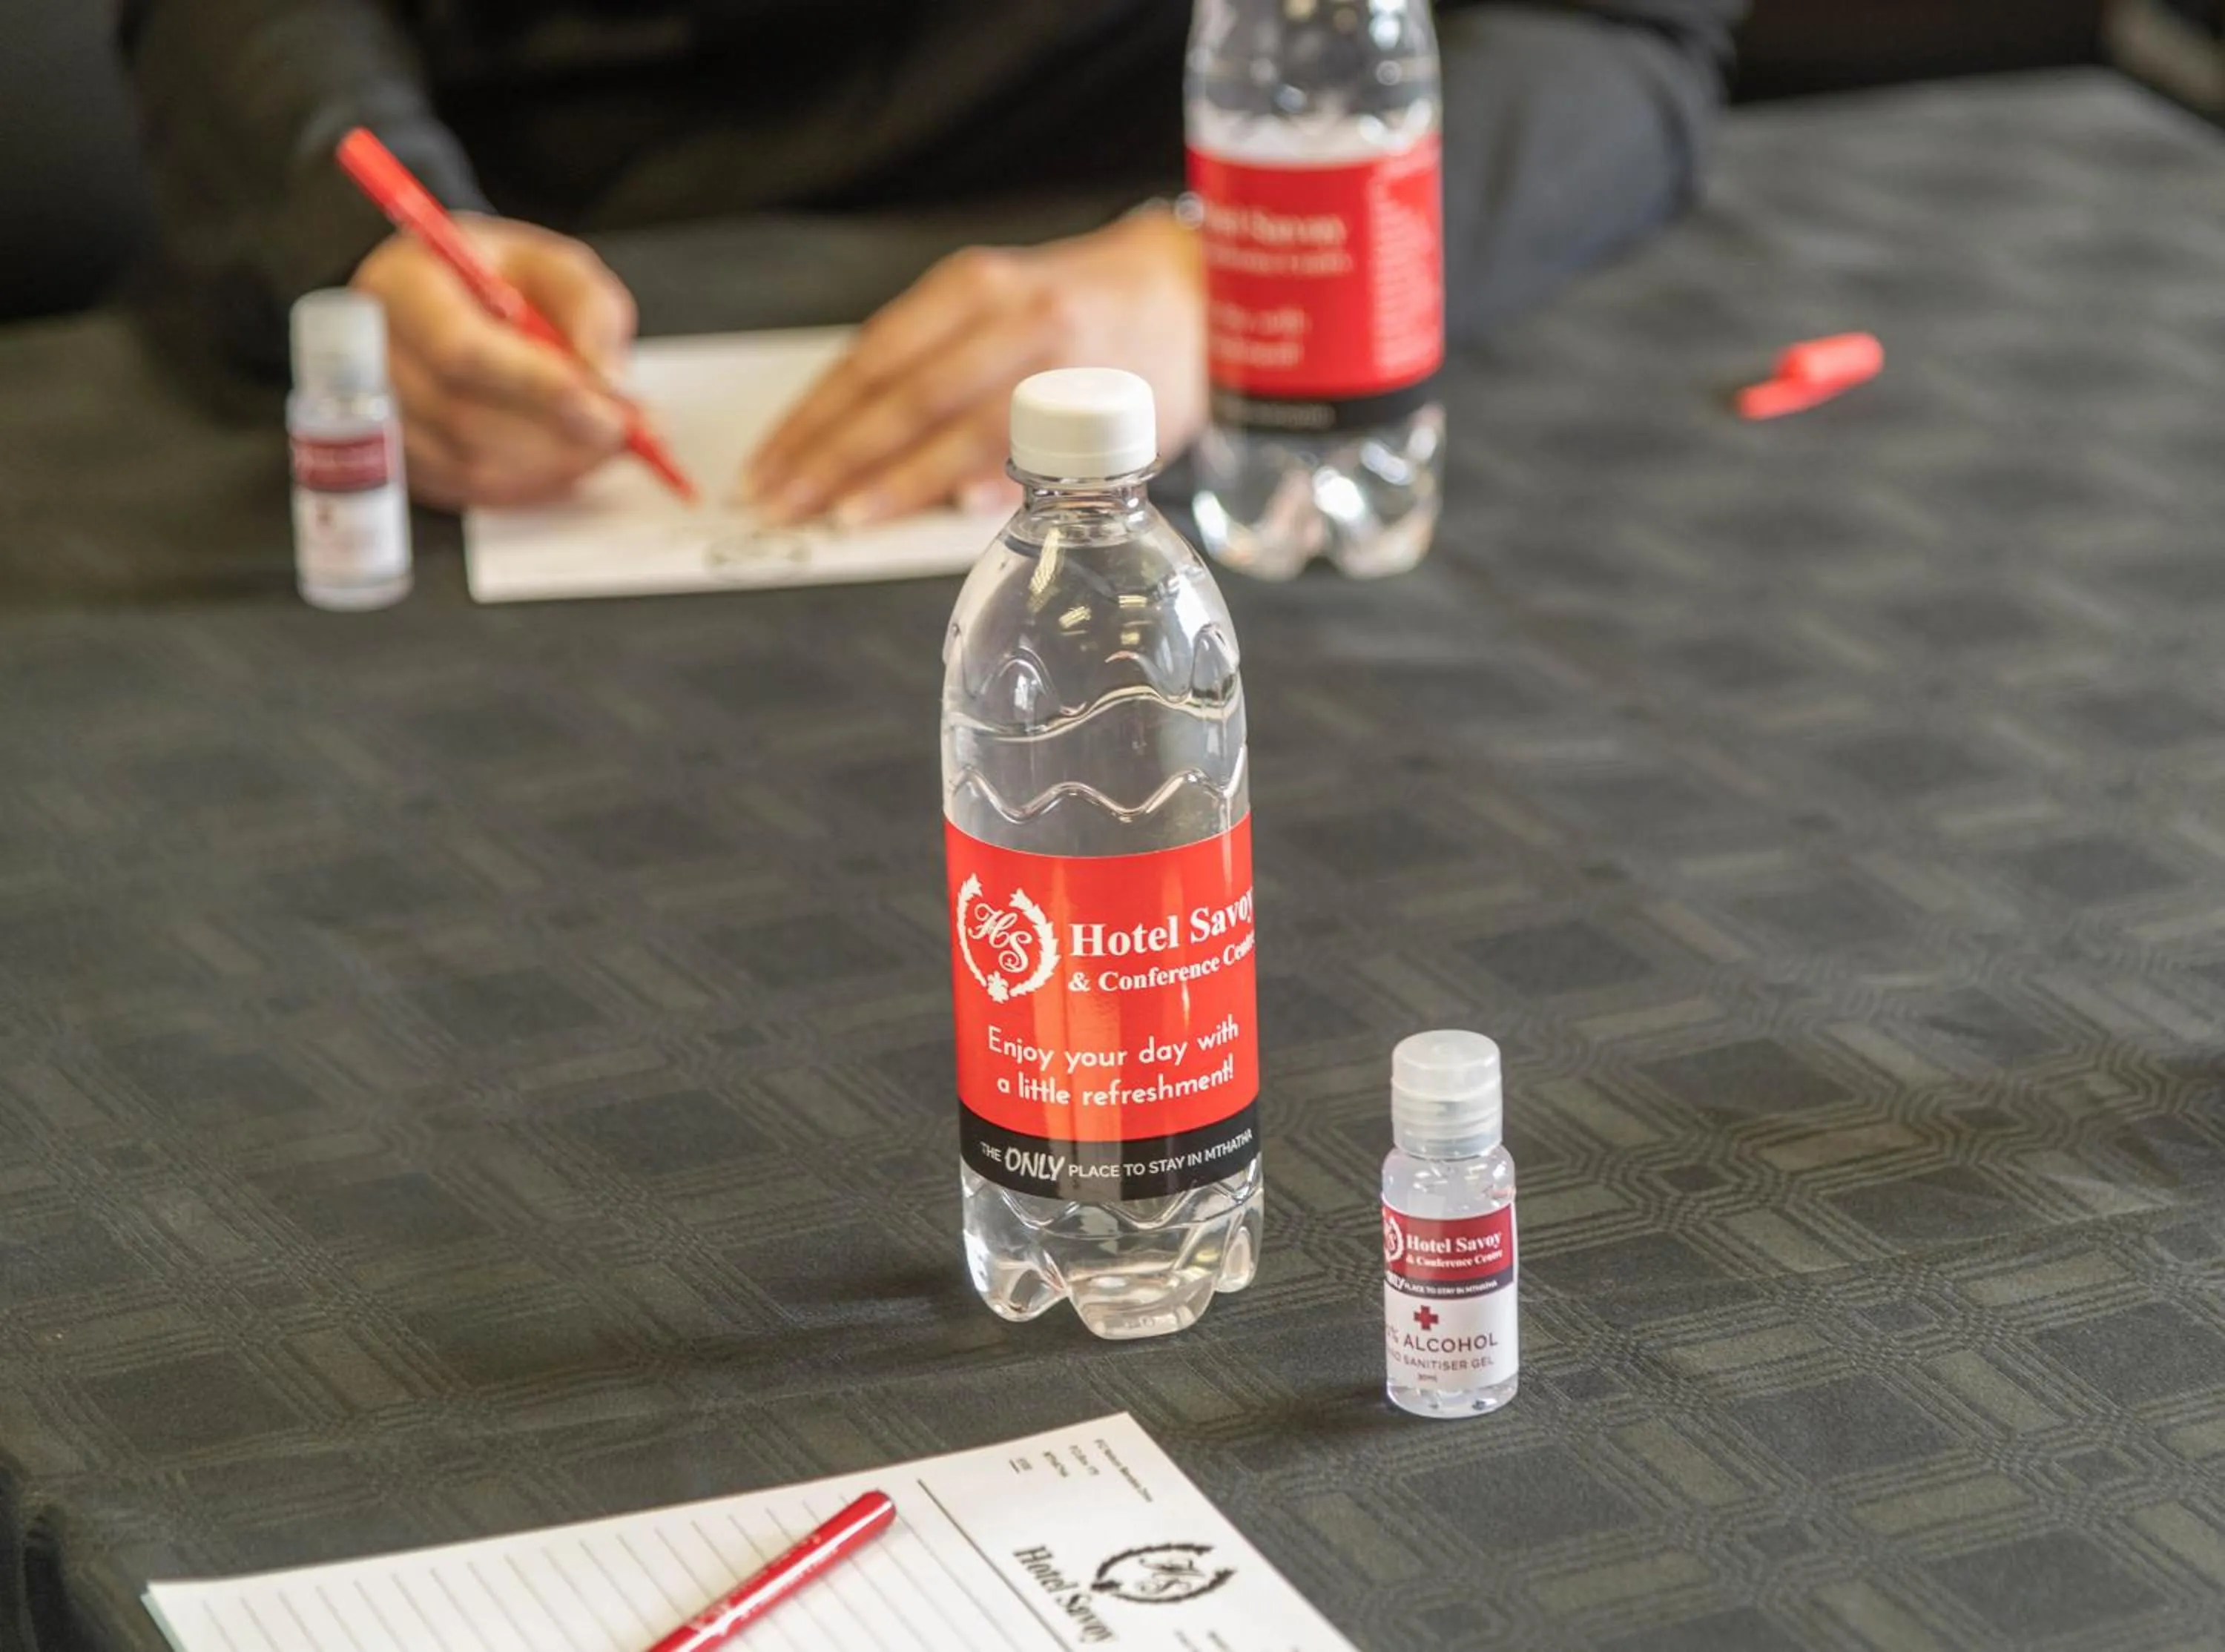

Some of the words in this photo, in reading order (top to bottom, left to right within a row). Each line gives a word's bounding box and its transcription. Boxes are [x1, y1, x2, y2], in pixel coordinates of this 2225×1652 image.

[1069, 915, 1179, 957] Hotel
[1068, 972, 1091, 992] &
[1098, 957, 1220, 992] Conference
[988, 1025, 1053, 1071] Enjoy
[1065, 1049, 1127, 1074] your
[1138, 1036, 1187, 1065] day
[1196, 1014, 1239, 1051] with
[997, 1077, 1009, 1094] a
[1018, 1072, 1070, 1105] little
[1081, 1054, 1235, 1106] refreshment!
[979, 1140, 1002, 1162] THE
[1004, 1146, 1066, 1181] ONLY
[1068, 1164, 1121, 1177] PLACE
[1123, 1163, 1145, 1177] TO
[1149, 1155, 1185, 1174] STAY
[1187, 1152, 1202, 1166] IN
[1204, 1128, 1253, 1162] MTHATHA
[1405, 1234, 1452, 1253] Hotel
[1455, 1232, 1502, 1252] Savoy
[1403, 1332, 1498, 1353] ALCOHOL
[1403, 1354, 1468, 1371] SANITISER
[1471, 1355, 1494, 1369] GEL
[1012, 1545, 1080, 1593] Hotel
[1054, 1593, 1115, 1643] Savoy
